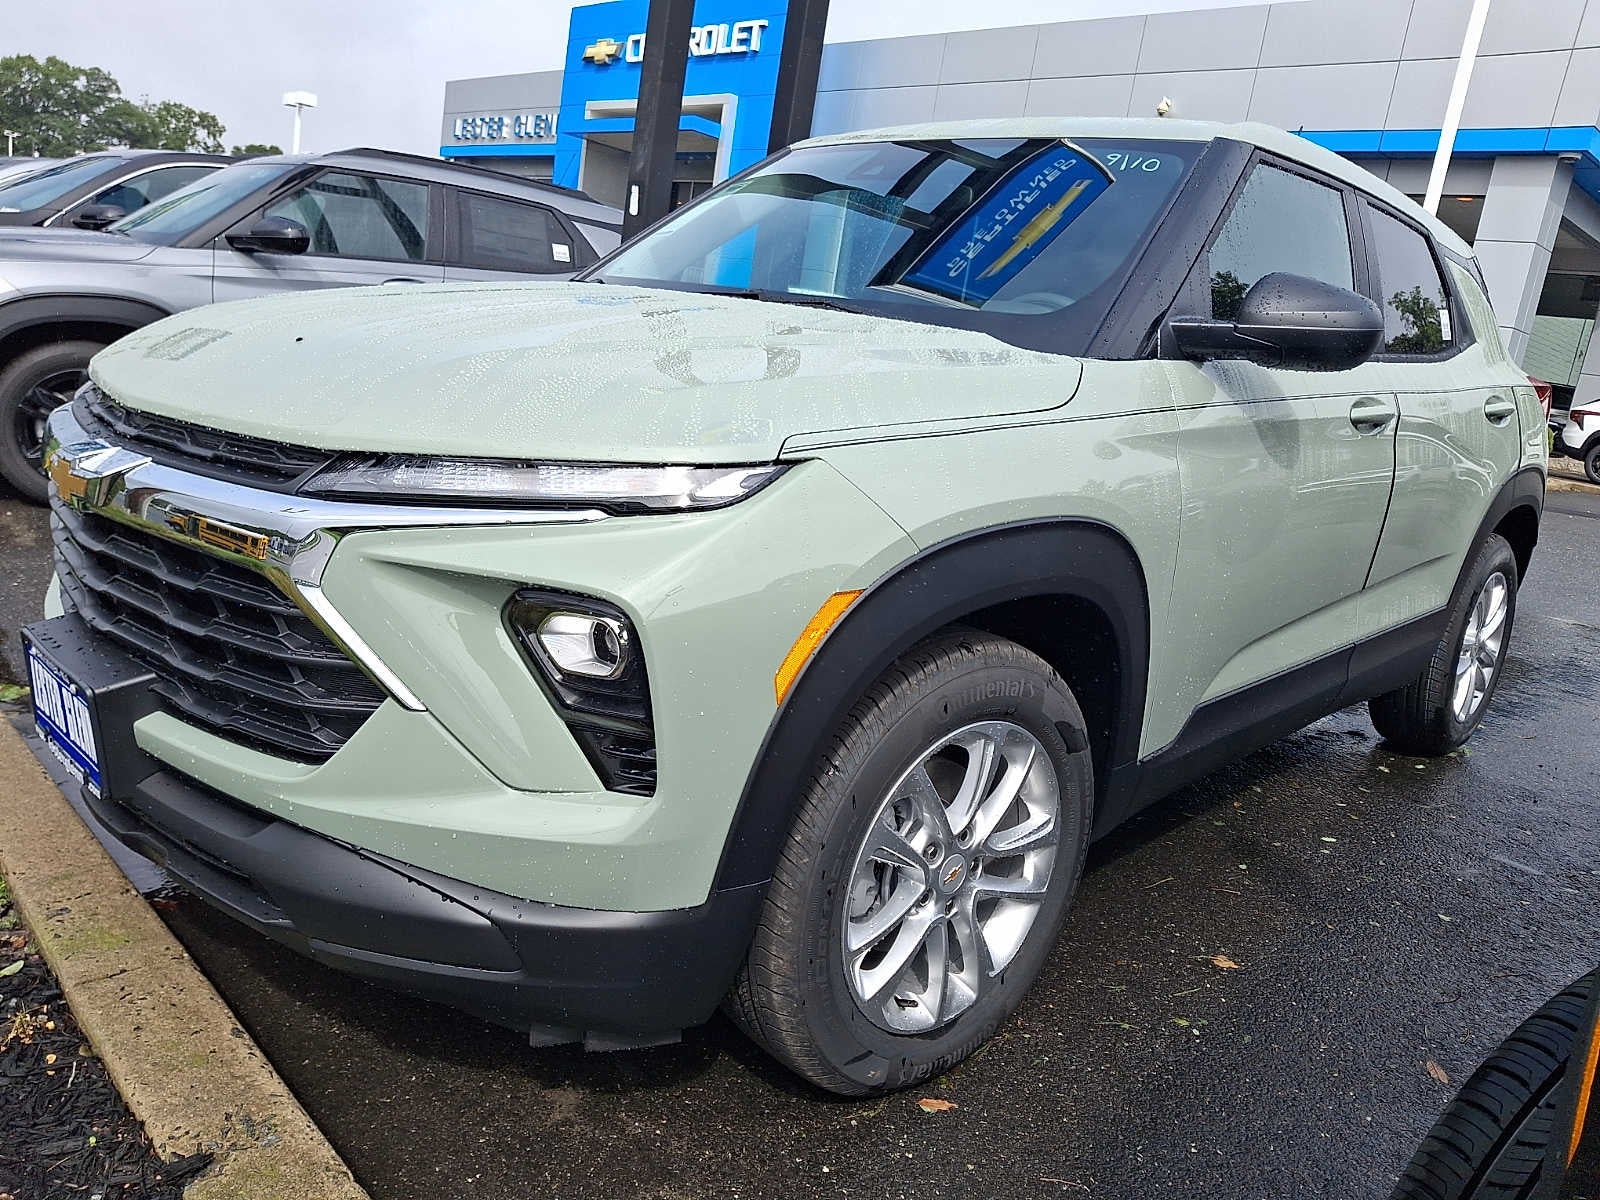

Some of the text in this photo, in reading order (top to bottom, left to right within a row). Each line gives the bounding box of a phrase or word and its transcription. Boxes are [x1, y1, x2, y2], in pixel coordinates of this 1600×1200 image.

[625, 19, 769, 63] CROLET
[454, 113, 558, 140] LESTER GLEN
[1106, 153, 1161, 171] 9/10
